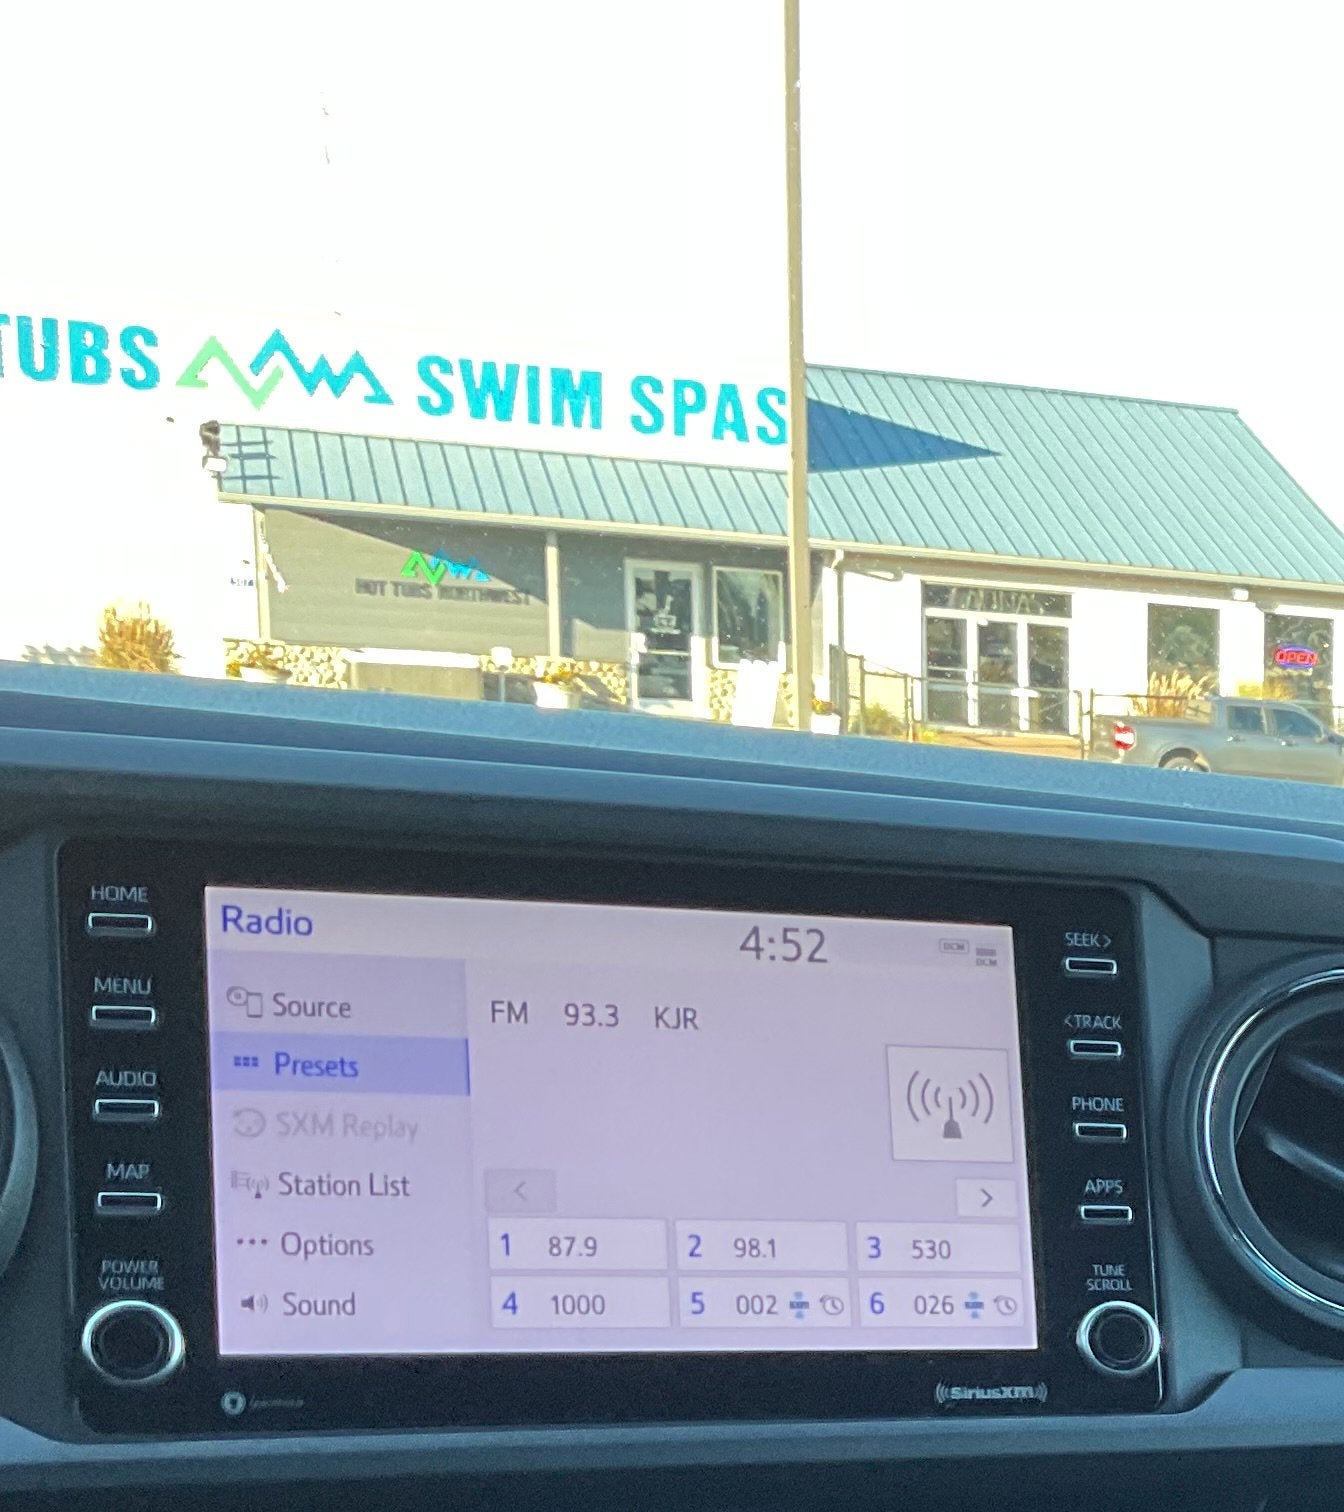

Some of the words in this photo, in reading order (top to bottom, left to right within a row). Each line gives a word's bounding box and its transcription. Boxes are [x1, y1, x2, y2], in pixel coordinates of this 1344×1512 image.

[417, 355, 602, 430] SWIM
[630, 376, 788, 445] SPAS
[1275, 649, 1318, 665] OPEN
[91, 886, 149, 902] HOME
[221, 905, 313, 936] Radio
[738, 926, 829, 964] 4:52
[94, 976, 151, 995] MENU
[273, 992, 352, 1018] Source
[491, 1000, 528, 1024] FM
[564, 1002, 619, 1027] 93.3
[654, 1006, 699, 1031] KJR
[275, 1052, 359, 1078] Presets
[96, 1071, 157, 1087] AUDIO
[1072, 1096, 1124, 1112] PHONE
[276, 1111, 334, 1137] SXM
[343, 1112, 419, 1144] Replay
[107, 1164, 150, 1180] MAP
[278, 1171, 361, 1196] Station
[369, 1172, 411, 1197] List
[1085, 1179, 1123, 1194] APPS
[281, 1231, 374, 1261] Options
[501, 1233, 511, 1256] 1
[548, 1236, 598, 1257] 87.9
[688, 1235, 703, 1257] 2
[733, 1238, 777, 1258] 98.1
[867, 1236, 882, 1259] 3
[911, 1239, 952, 1260] 530
[102, 1260, 159, 1274] POWER
[1092, 1264, 1125, 1277] TUNE
[98, 1276, 165, 1291] VOLUME
[1086, 1278, 1133, 1291] SCROLL
[282, 1291, 356, 1316] Sound
[502, 1291, 518, 1315] 4
[550, 1294, 606, 1316] 1000
[690, 1291, 705, 1315] 5
[736, 1295, 779, 1316] 002
[869, 1291, 885, 1315] 6
[914, 1295, 955, 1316] 026
